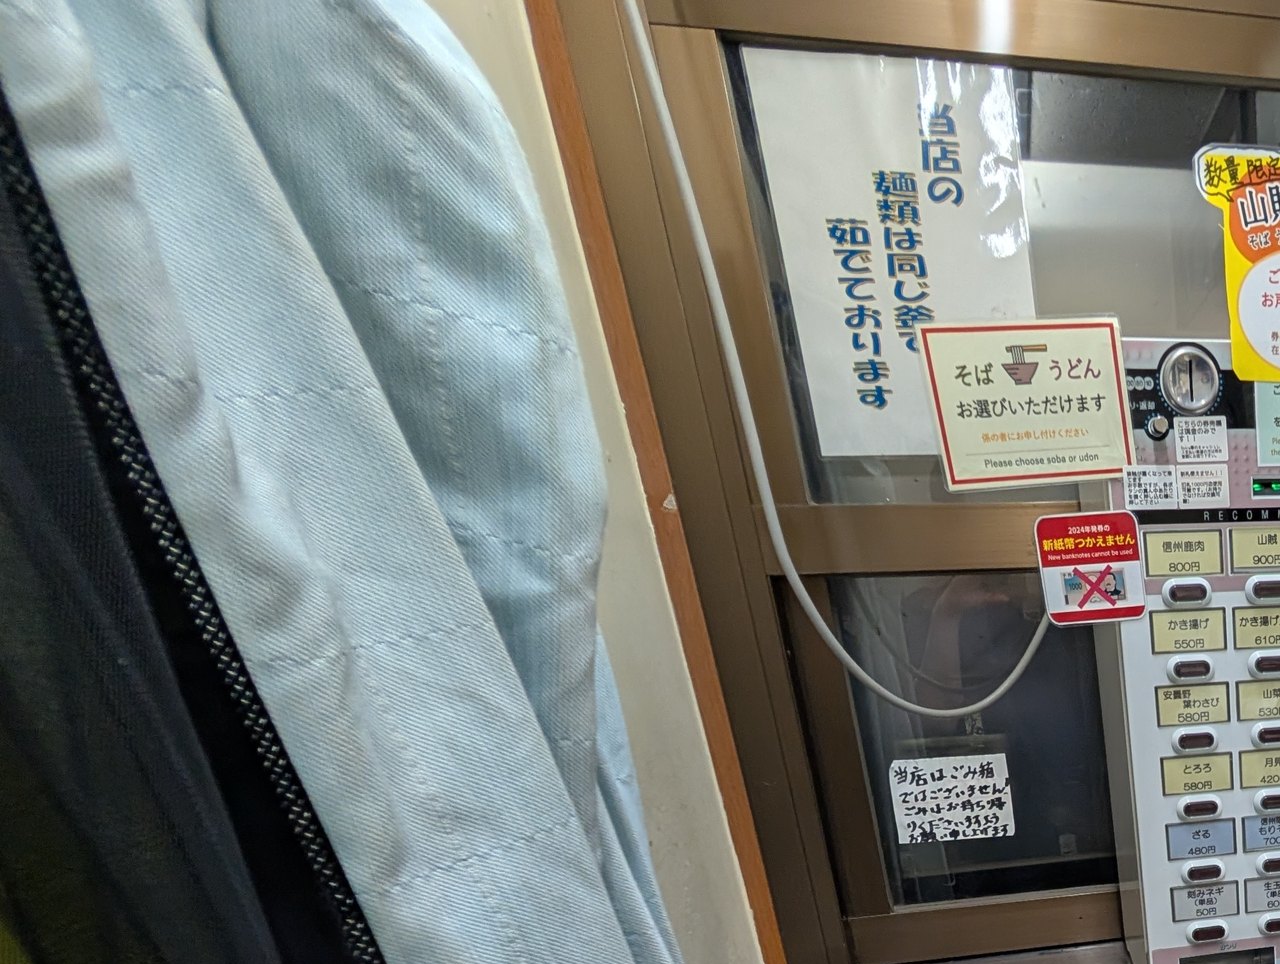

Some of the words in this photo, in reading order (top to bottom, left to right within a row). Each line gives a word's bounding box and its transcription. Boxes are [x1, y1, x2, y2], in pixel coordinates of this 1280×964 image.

[918, 102, 965, 208] 当店の
[1248, 231, 1270, 249] そば
[826, 217, 893, 410] 茹でております
[954, 362, 994, 387] そば
[1049, 358, 1101, 381] うどん
[956, 393, 1106, 419] お選びいただけます
[981, 429, 1089, 444] 係の者にお申し付けください
[1271, 448, 1280, 456] the
[984, 456, 1013, 469] Please
[1014, 456, 1045, 467] choose
[1046, 454, 1067, 465] soba
[1068, 455, 1078, 463] or
[1079, 453, 1099, 463] udon
[1042, 533, 1136, 552] 新紙幣つかえません
[1257, 533, 1278, 546] 山賊
[1162, 540, 1205, 553] 信州鹿肉
[1061, 552, 1091, 560] banknotes
[1168, 561, 1200, 572] 800円
[1167, 618, 1209, 631] かき揚げ
[1174, 638, 1205, 649] 550円
[1162, 689, 1191, 701] 安曇野
[1182, 697, 1220, 709] 葉わさび
[1177, 711, 1210, 723] 580円
[893, 760, 995, 787] 当店はごみ箱
[1182, 763, 1212, 775] とろろ
[1183, 780, 1213, 791] 580円
[903, 796, 1007, 817] ごみはお持ち帰
[1191, 829, 1211, 840] ざる
[1187, 845, 1216, 856] 480円
[1186, 887, 1225, 900] 刻みネギ
[1195, 907, 1217, 917] 50円
